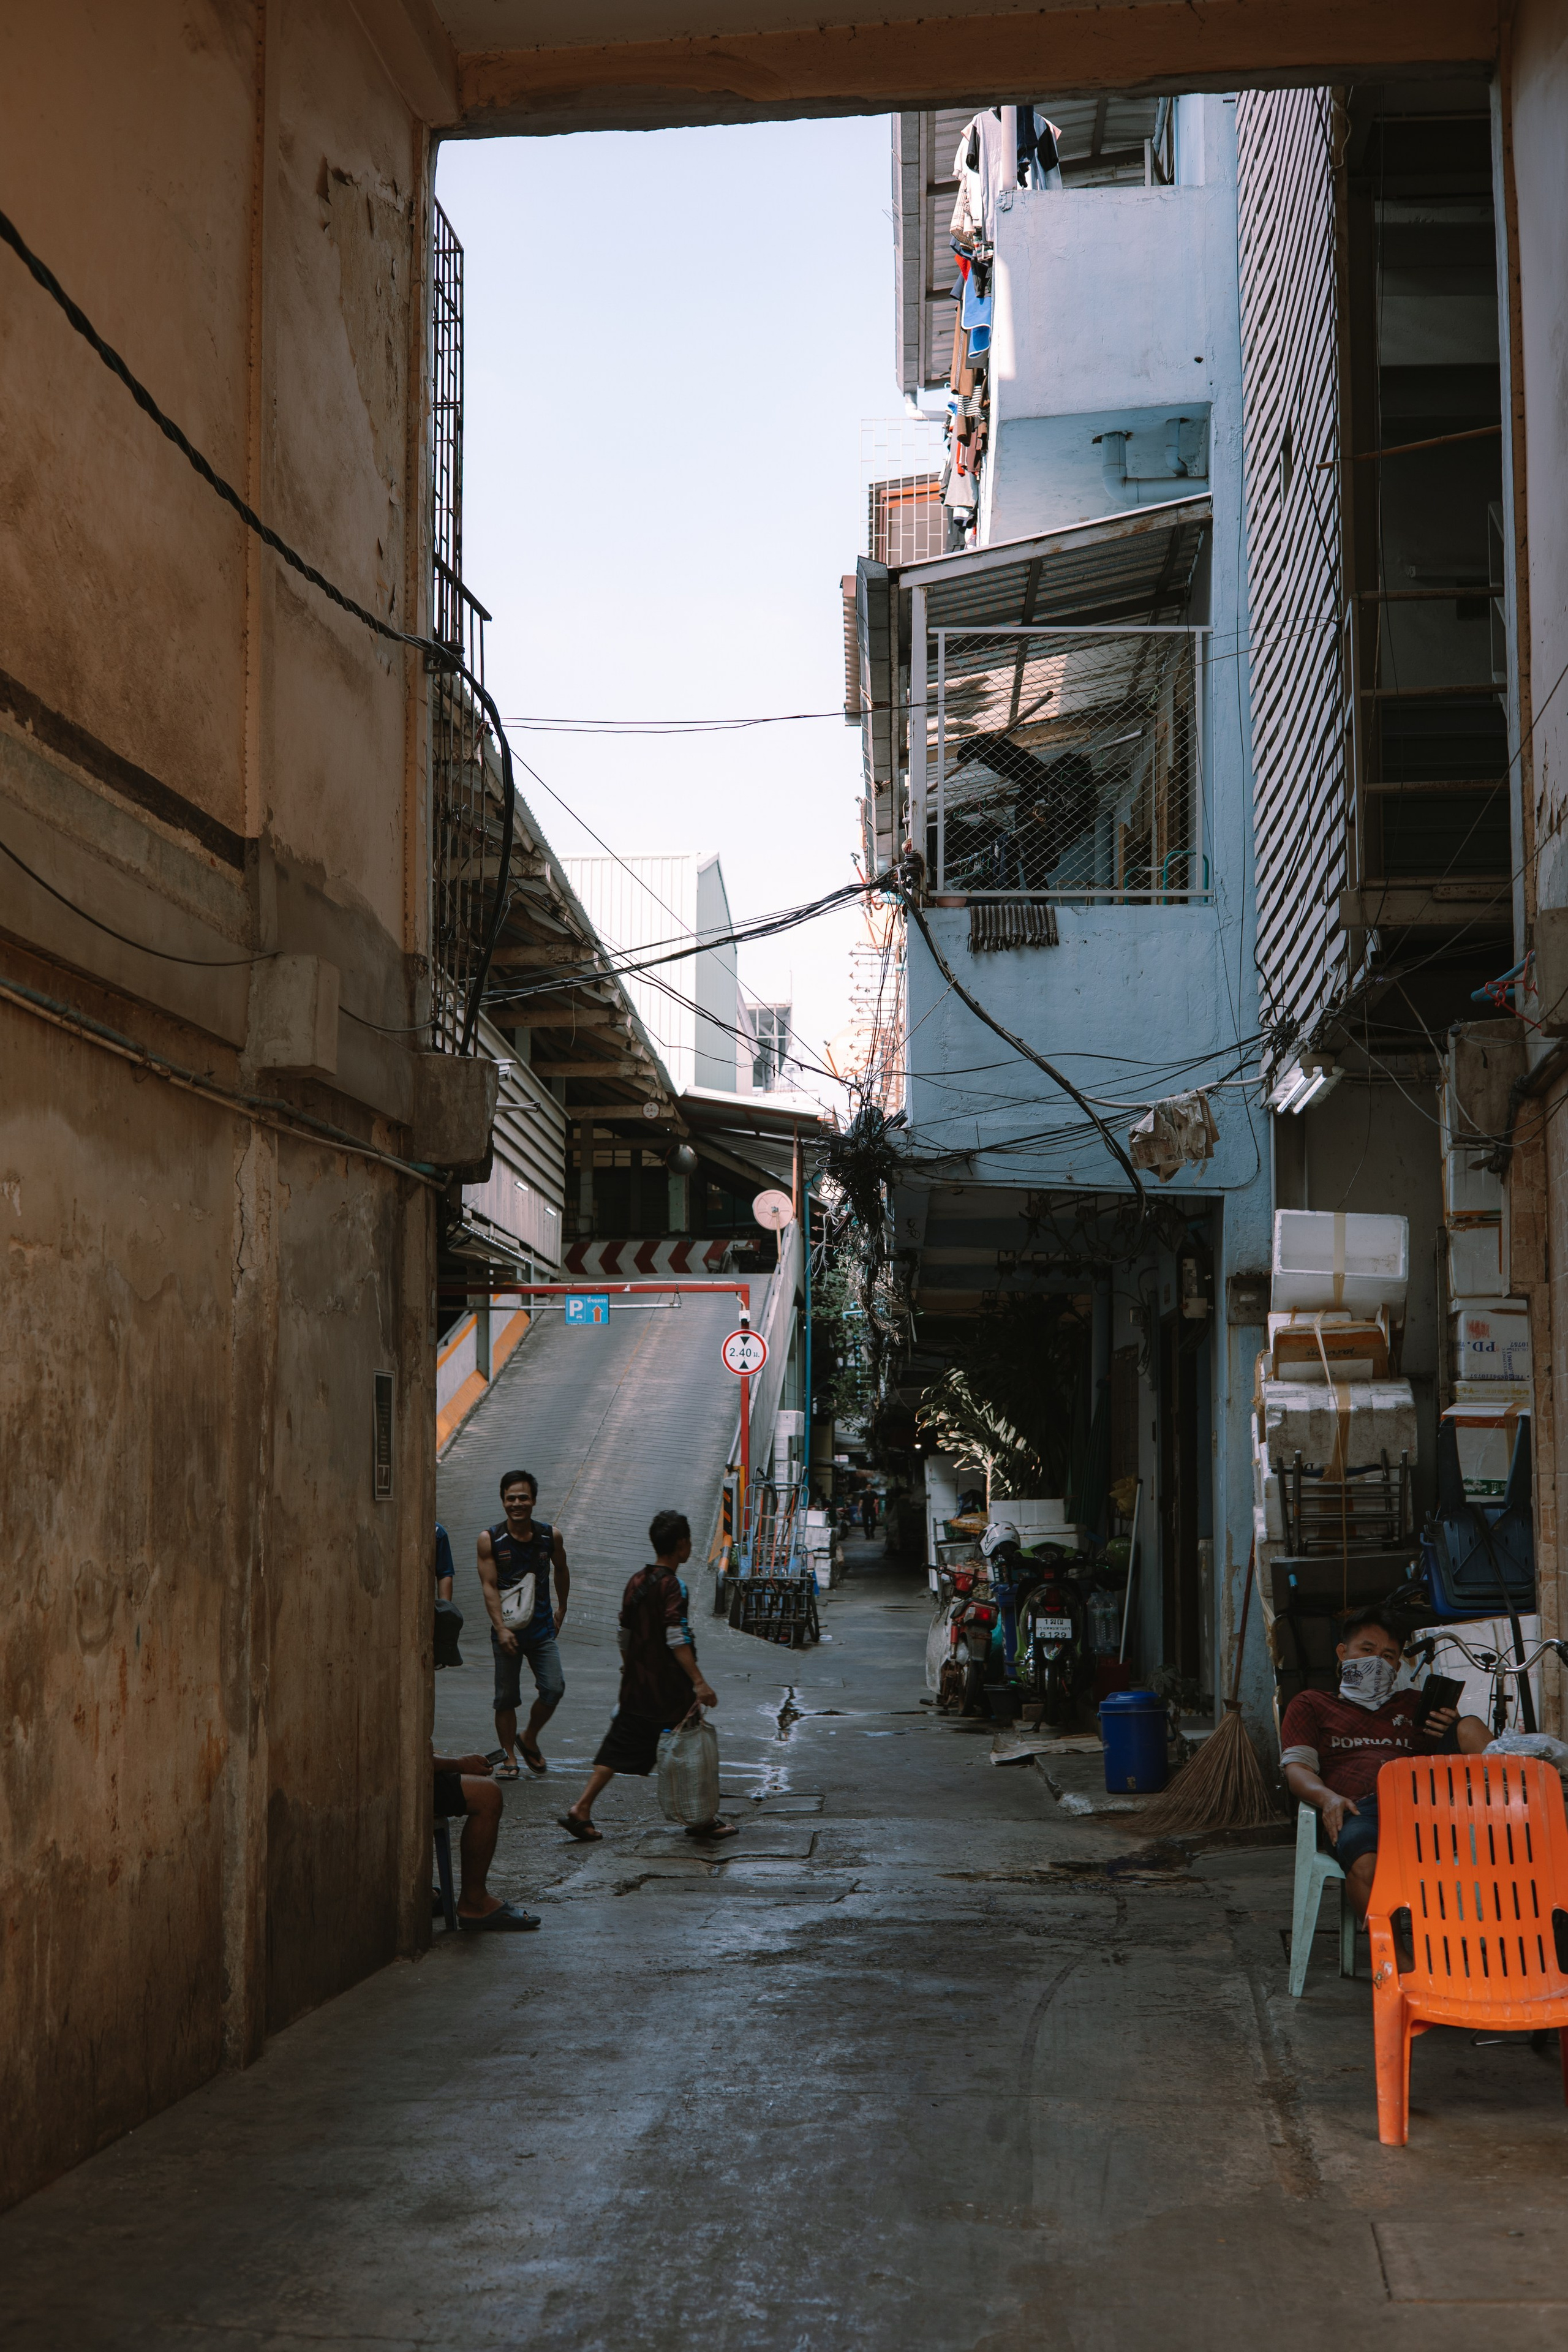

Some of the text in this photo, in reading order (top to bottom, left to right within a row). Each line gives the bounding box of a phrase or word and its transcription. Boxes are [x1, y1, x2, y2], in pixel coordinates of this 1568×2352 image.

[569, 1300, 584, 1317] P
[729, 1348, 752, 1357] 2.40
[1467, 1341, 1496, 1352] PD.
[1330, 1736, 1413, 1750] PORTUGAL
